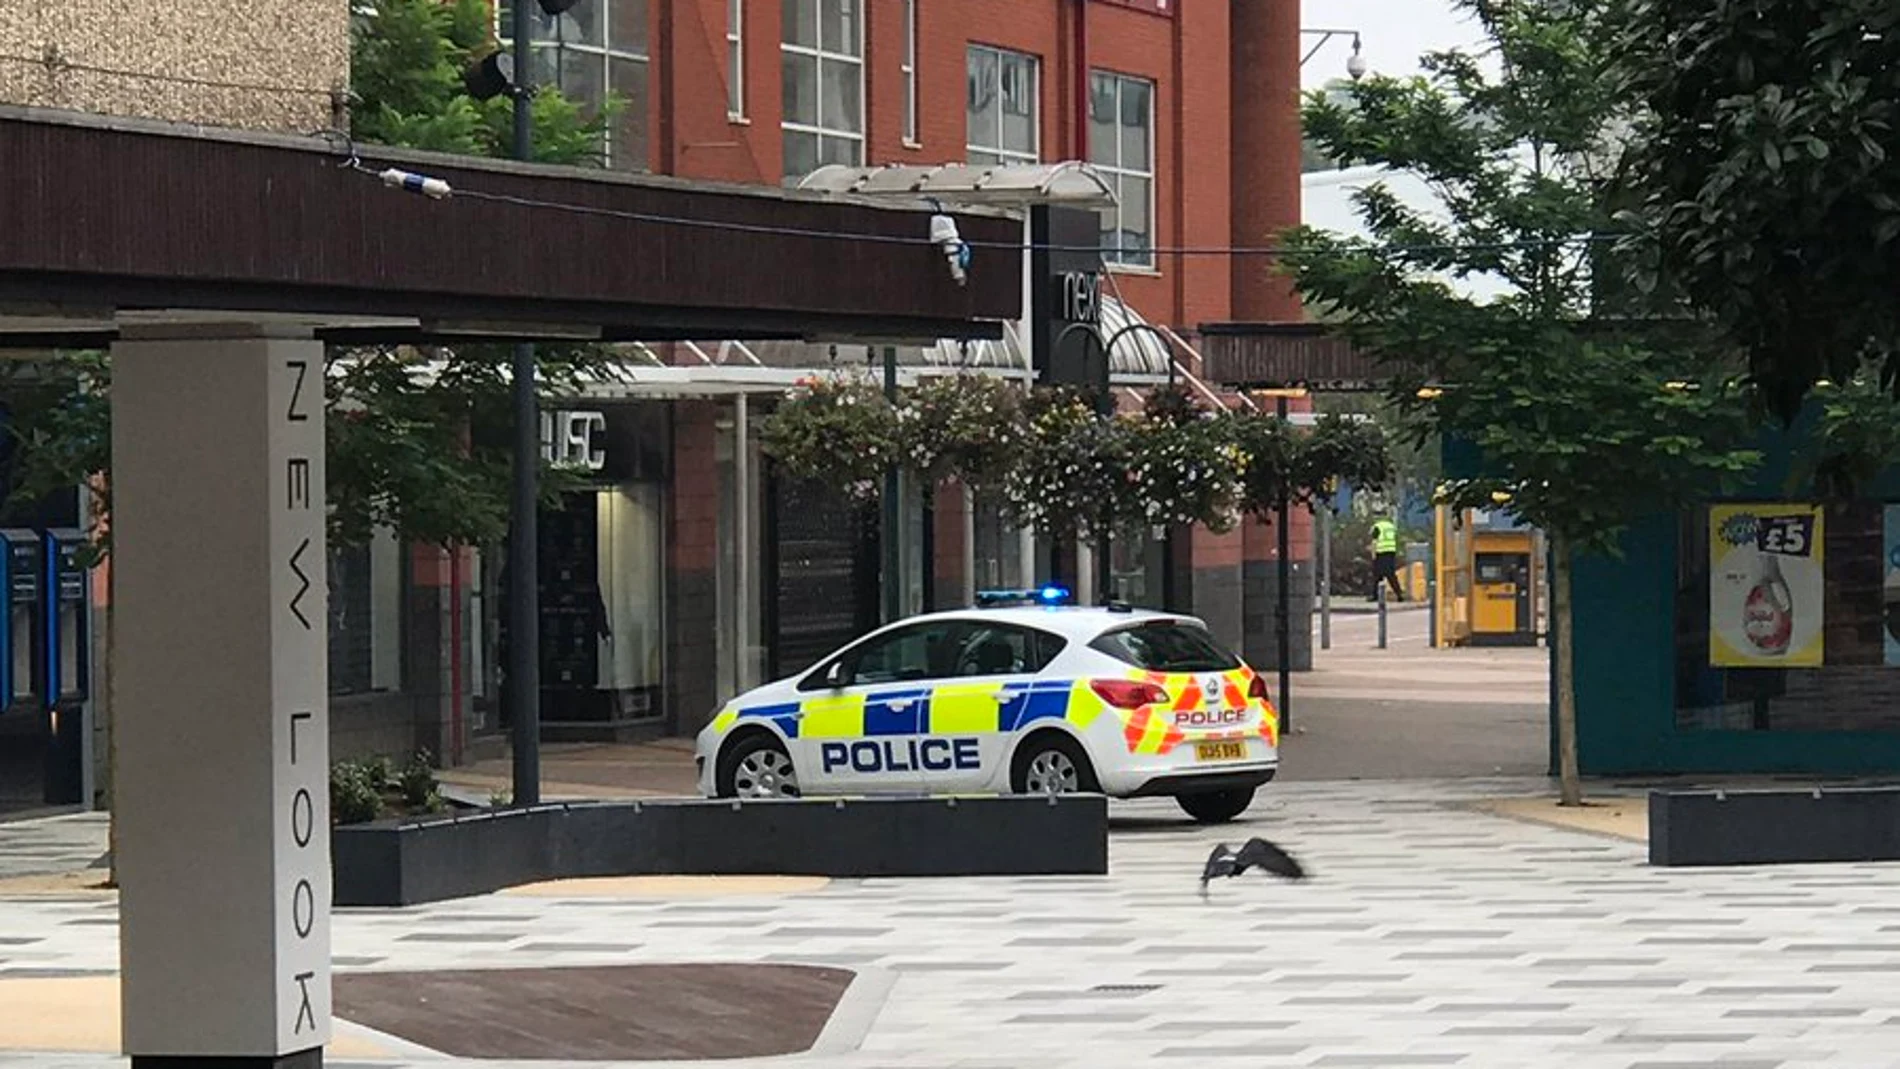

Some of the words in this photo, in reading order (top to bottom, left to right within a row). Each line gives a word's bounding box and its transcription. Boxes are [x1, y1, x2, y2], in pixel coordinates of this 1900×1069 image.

[286, 361, 311, 630] NEW
[1764, 522, 1805, 553] £5
[1175, 709, 1246, 725] POLICE
[821, 738, 981, 774] POLICE
[290, 711, 315, 1035] LOOK
